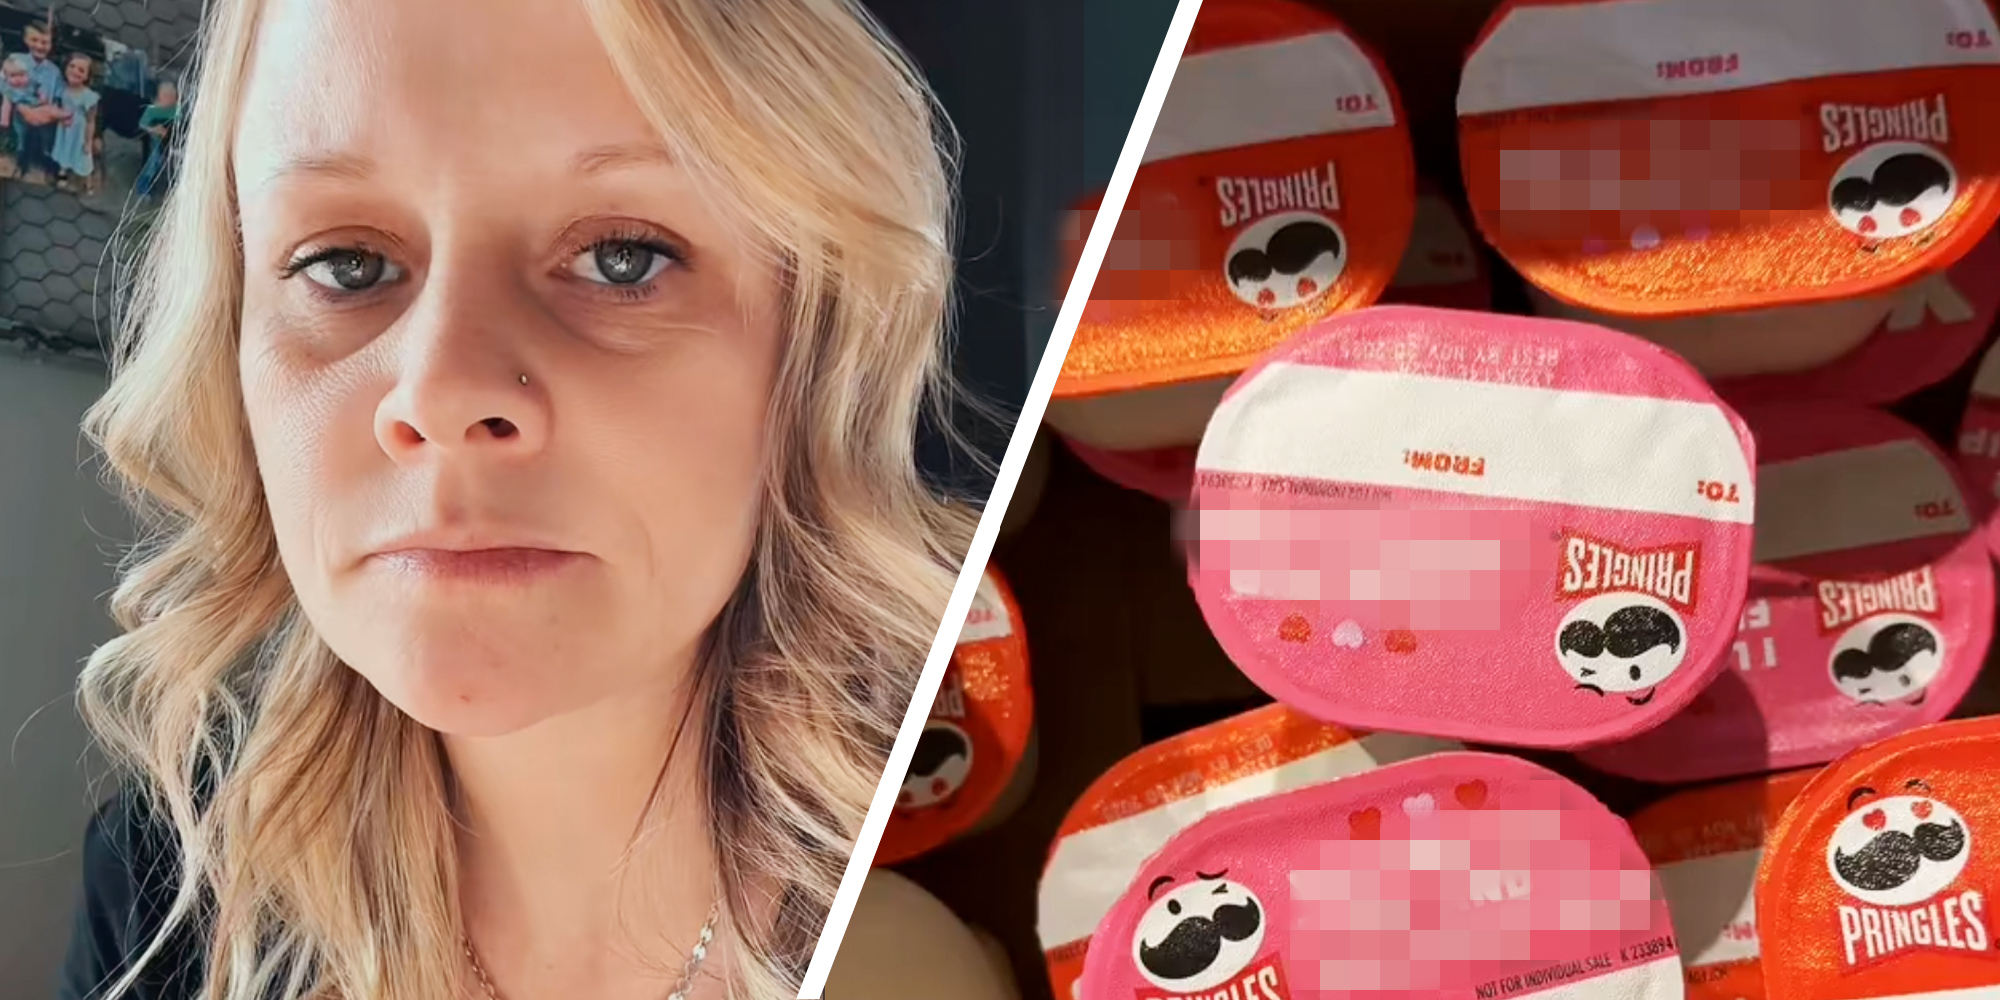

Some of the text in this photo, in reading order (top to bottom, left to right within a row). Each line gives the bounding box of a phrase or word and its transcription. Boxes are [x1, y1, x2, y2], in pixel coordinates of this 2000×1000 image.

[1946, 28, 1992, 49] TO:
[1656, 53, 1740, 80] FROM:
[1335, 95, 1378, 114] TO:
[1819, 92, 1949, 153] PRINGLES
[1215, 160, 1340, 227] PRINGLES
[1403, 449, 1486, 477] FROM:
[1697, 480, 1740, 503] TO:
[1915, 500, 1955, 518] TO:
[1562, 538, 1695, 604] PRINGLES
[1818, 564, 1938, 628] PRINGLES
[1838, 891, 1988, 966] PRINGLES
[1475, 935, 1674, 999] NOT FOR INDIVIDUAL SALE K 233894
